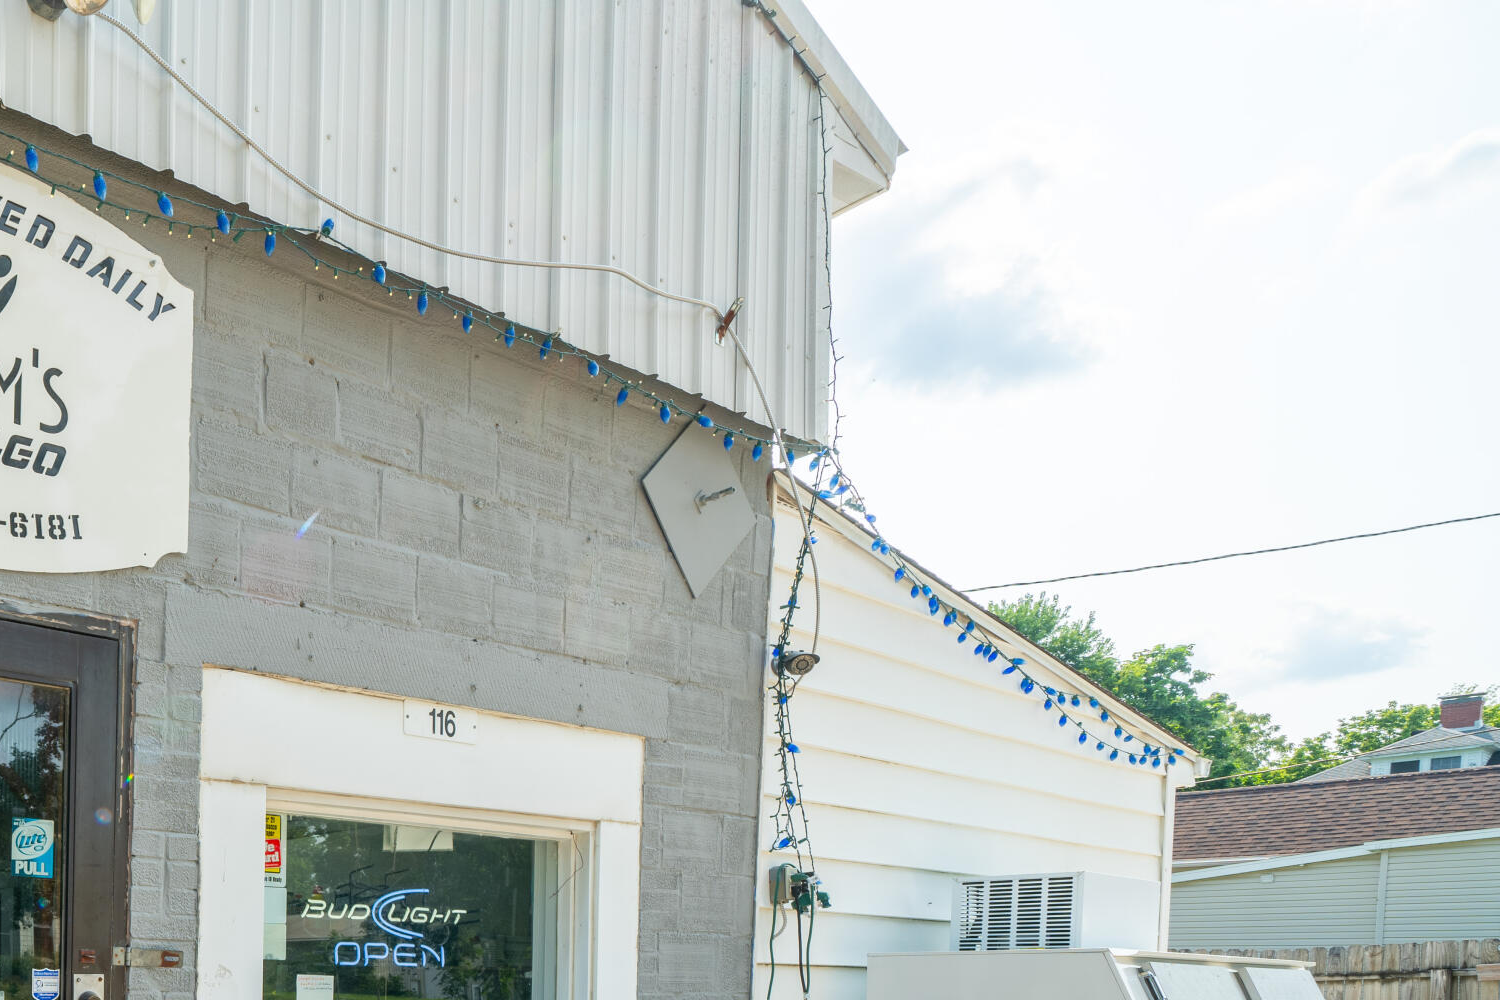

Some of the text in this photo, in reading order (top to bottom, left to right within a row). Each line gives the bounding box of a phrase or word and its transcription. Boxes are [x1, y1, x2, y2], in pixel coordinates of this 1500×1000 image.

[62, 235, 176, 322] DAILY
[429, 708, 456, 738] 116
[15, 860, 49, 876] PULL
[301, 899, 467, 925] BUD LIGHT
[334, 941, 445, 967] OPEN
